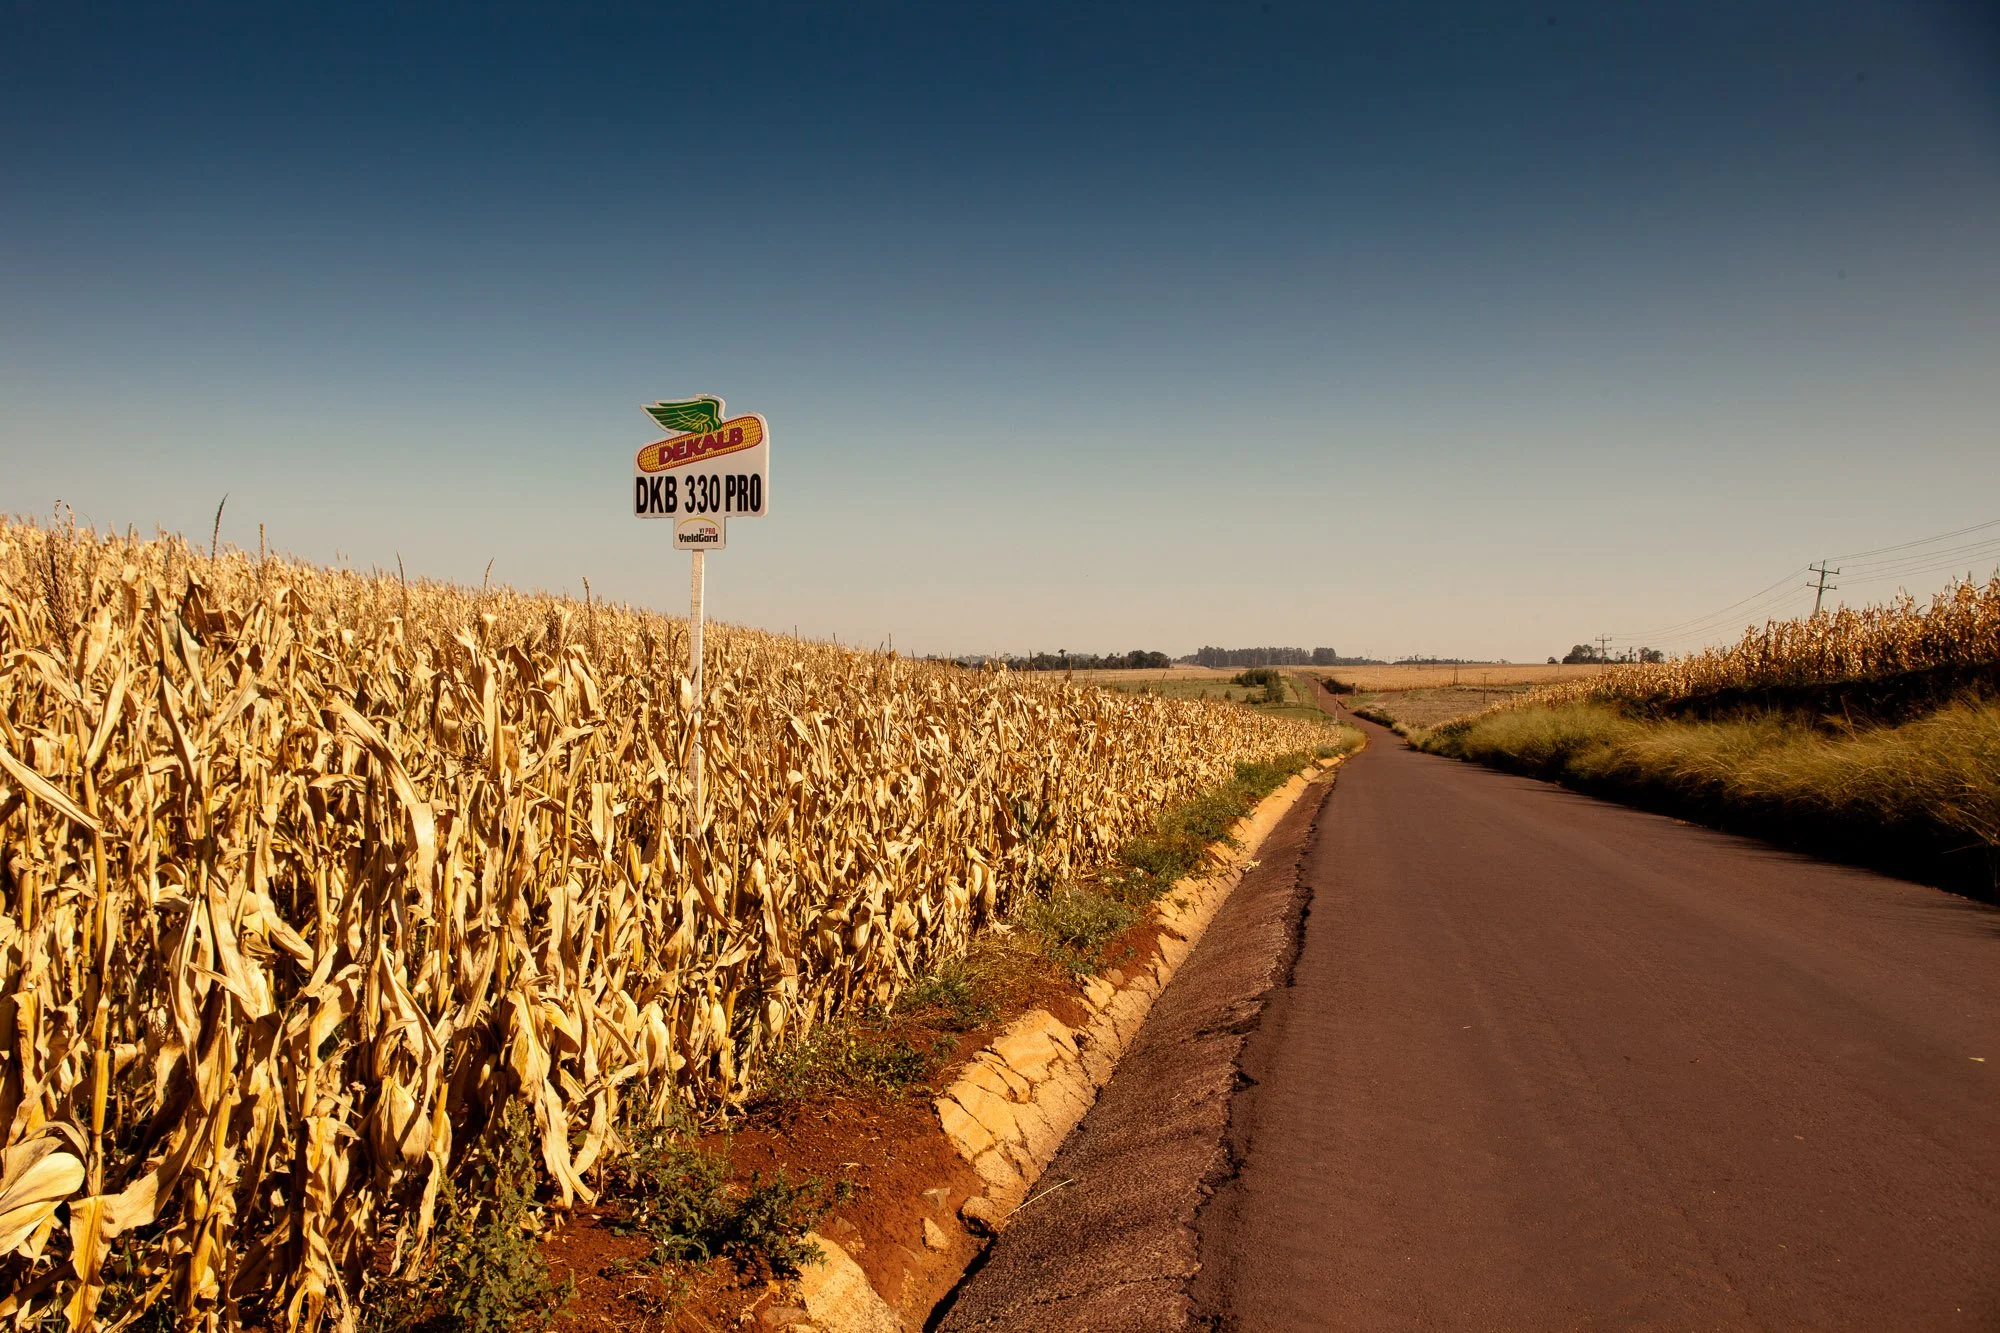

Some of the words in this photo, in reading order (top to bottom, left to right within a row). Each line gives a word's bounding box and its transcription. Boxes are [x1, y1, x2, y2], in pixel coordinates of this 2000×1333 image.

[659, 427, 744, 466] DEKALB
[636, 476, 678, 513] DKB
[685, 474, 720, 513] 330
[725, 473, 762, 512] PRO
